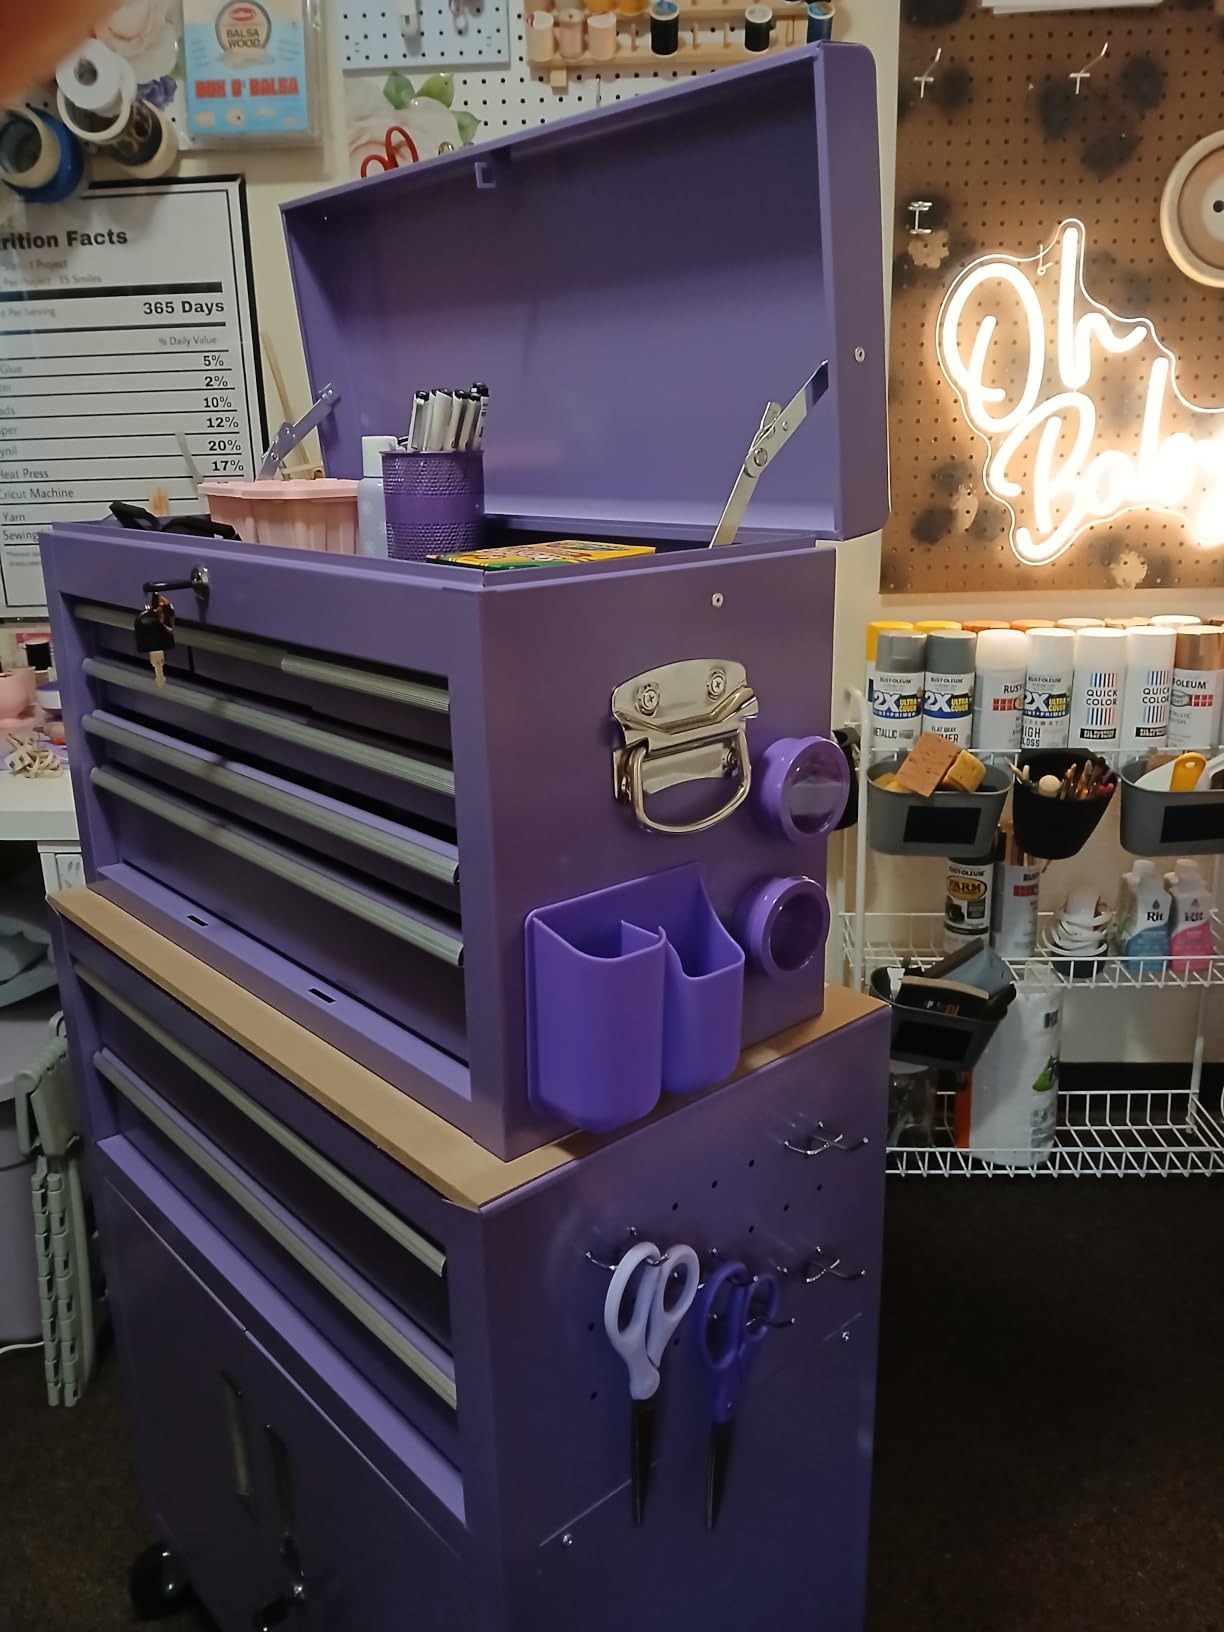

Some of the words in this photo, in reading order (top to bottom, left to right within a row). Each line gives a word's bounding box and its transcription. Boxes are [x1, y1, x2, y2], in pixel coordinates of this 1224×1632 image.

[226, 28, 260, 38] BALSA
[228, 38, 261, 49] WOOD
[66, 228, 128, 247] Facts
[143, 301, 175, 315] 365
[181, 300, 225, 316] Days
[943, 227, 1147, 433] Oh
[169, 336, 191, 348] Daily
[192, 335, 217, 345] Value
[203, 355, 224, 367] 5%
[205, 375, 228, 387] 2%
[203, 396, 232, 408] 10%
[206, 416, 239, 428] 12%
[208, 440, 241, 452] 20%
[23, 468, 49, 479] Press
[211, 460, 244, 472] 17%
[30, 487, 74, 498] Machine
[2, 511, 26, 521] Yarn
[2, 529, 39, 542] Sewing
[1086, 689, 1118, 698] QUICK
[873, 690, 901, 713] 2X
[924, 690, 952, 713] 2X
[1086, 698, 1117, 706] COLOR
[1147, 911, 1164, 922] Rit
